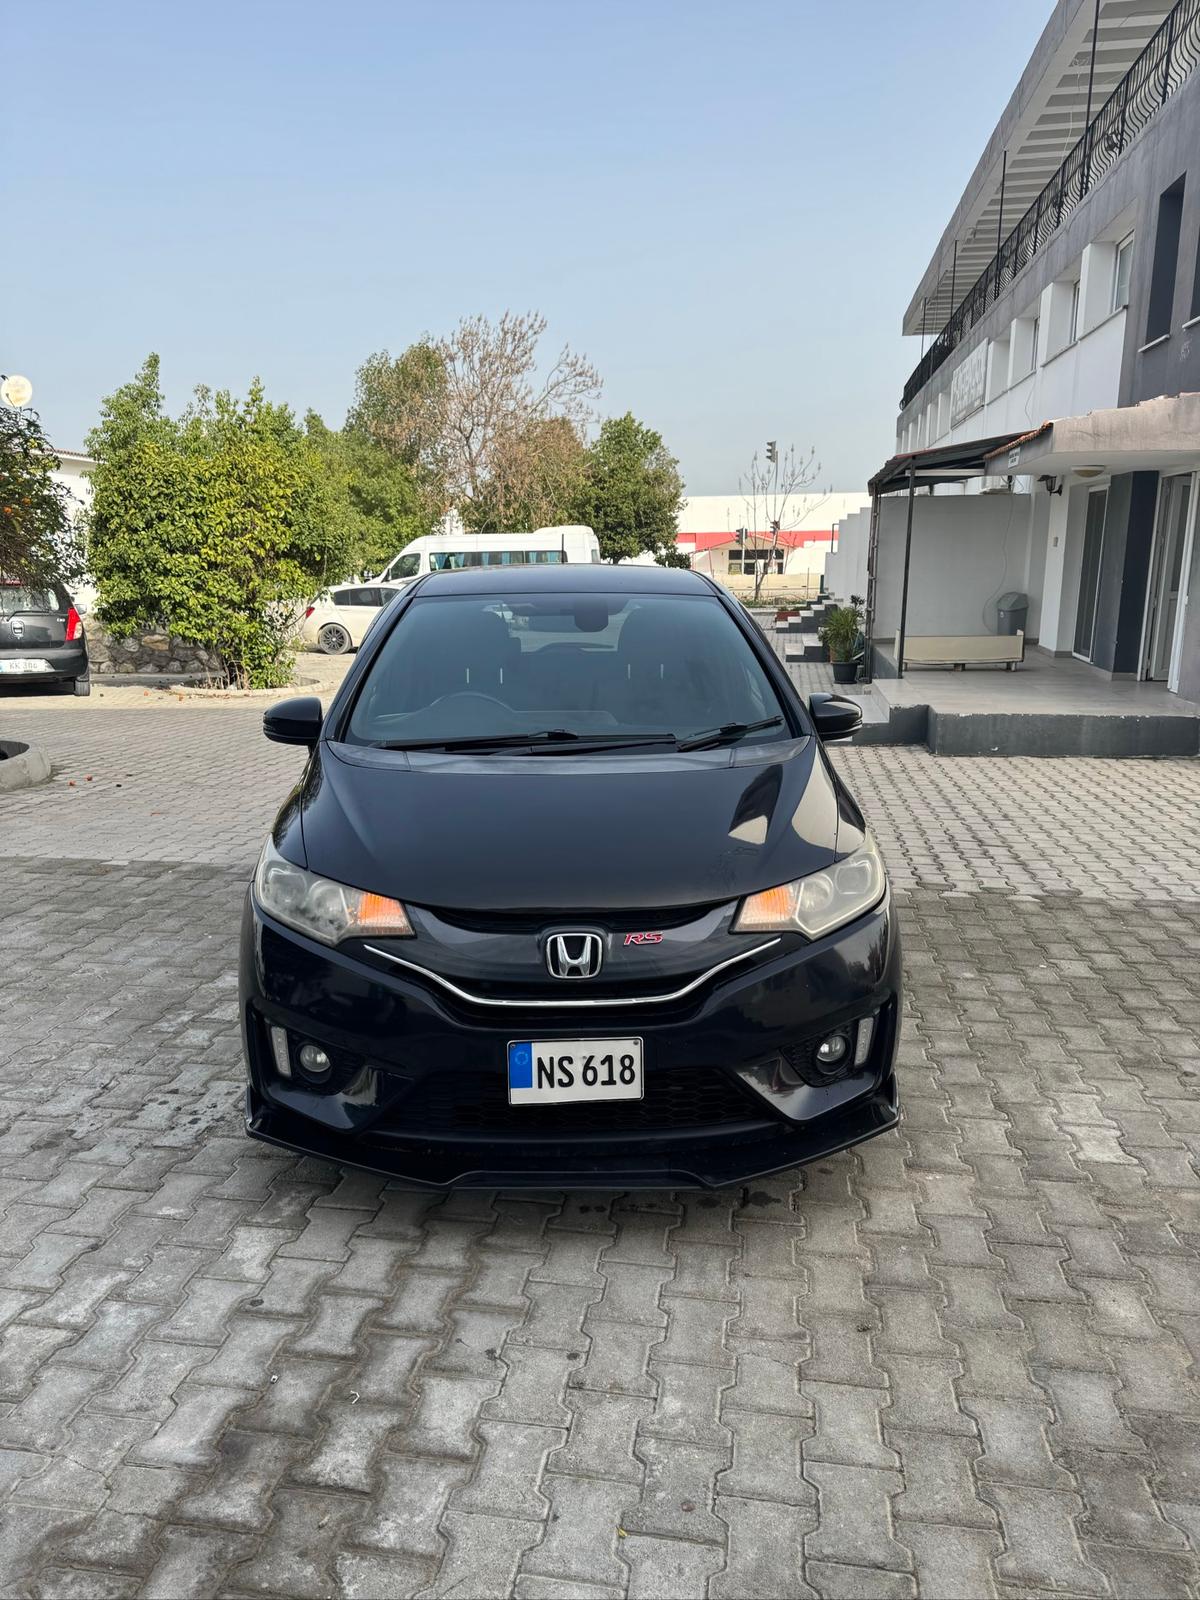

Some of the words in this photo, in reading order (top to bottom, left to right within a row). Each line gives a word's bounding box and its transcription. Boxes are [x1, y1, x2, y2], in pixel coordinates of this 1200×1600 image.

[624, 932, 664, 945] RS
[537, 1056, 574, 1089] NS
[582, 1055, 635, 1086] 618
